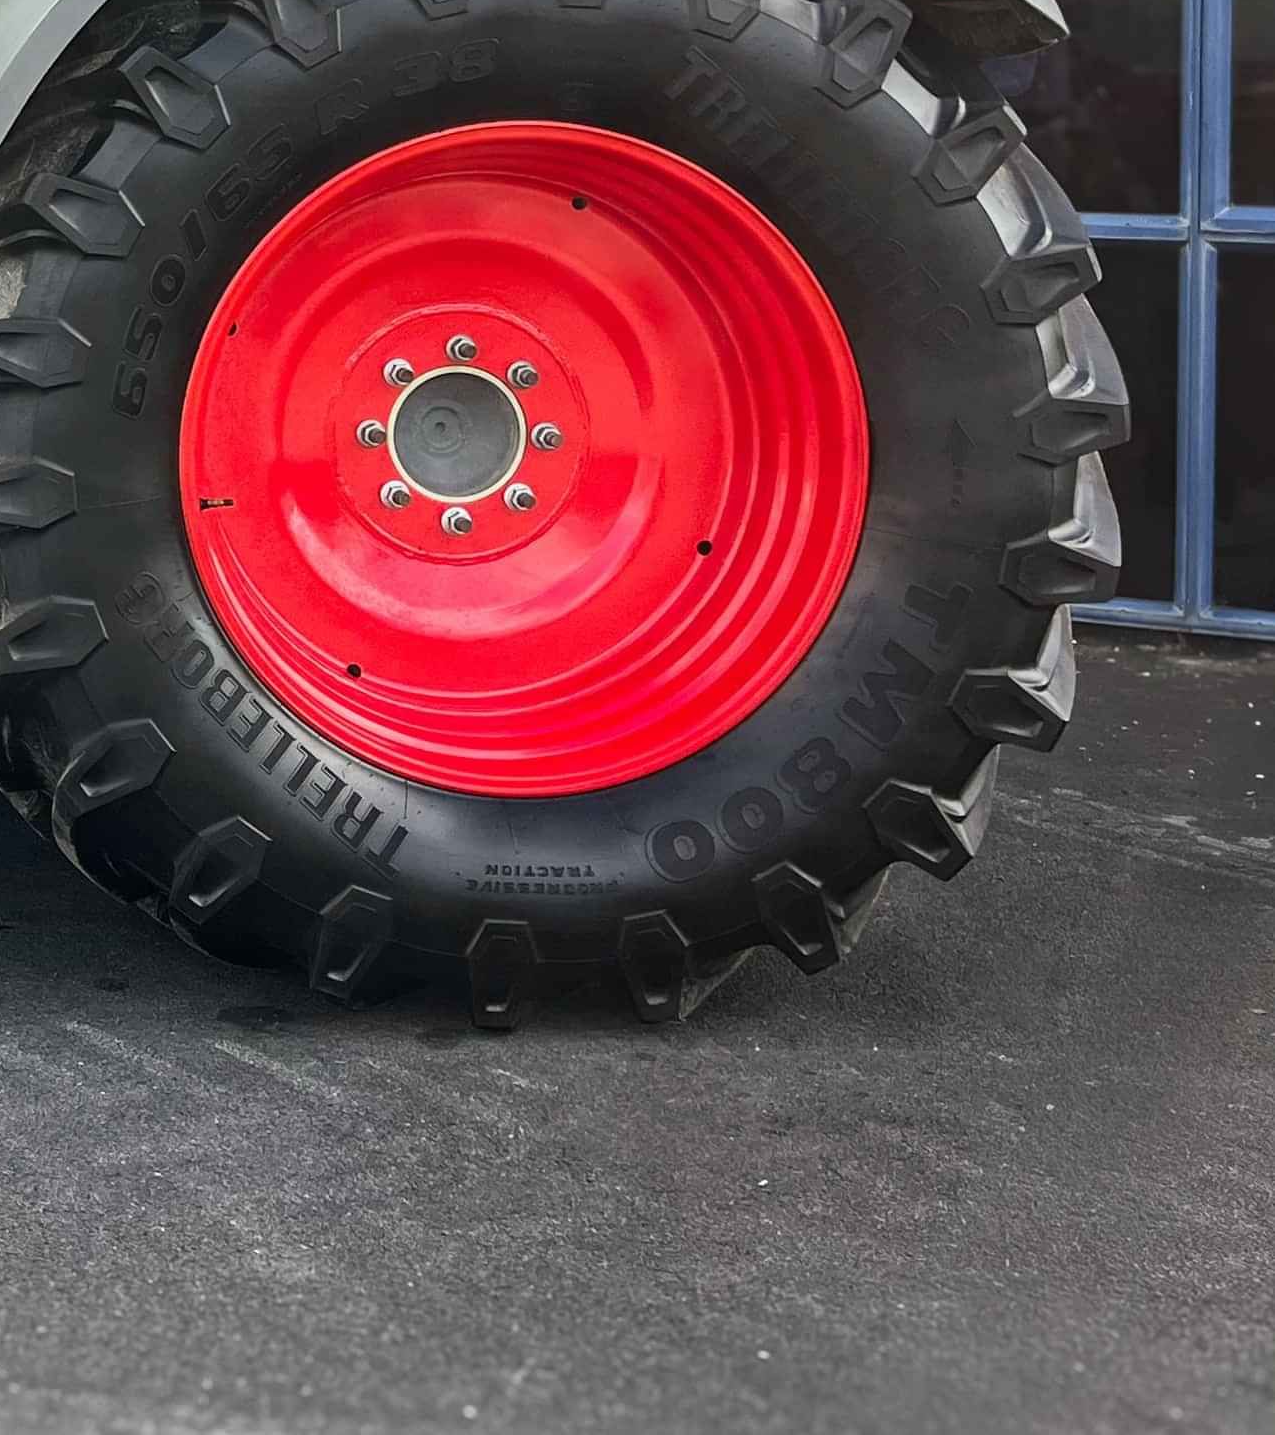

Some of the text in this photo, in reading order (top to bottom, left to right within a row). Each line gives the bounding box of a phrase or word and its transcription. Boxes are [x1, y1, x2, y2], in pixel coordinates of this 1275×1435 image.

[112, 570, 409, 880] TRELLEBORG
[644, 581, 974, 884] TM 800
